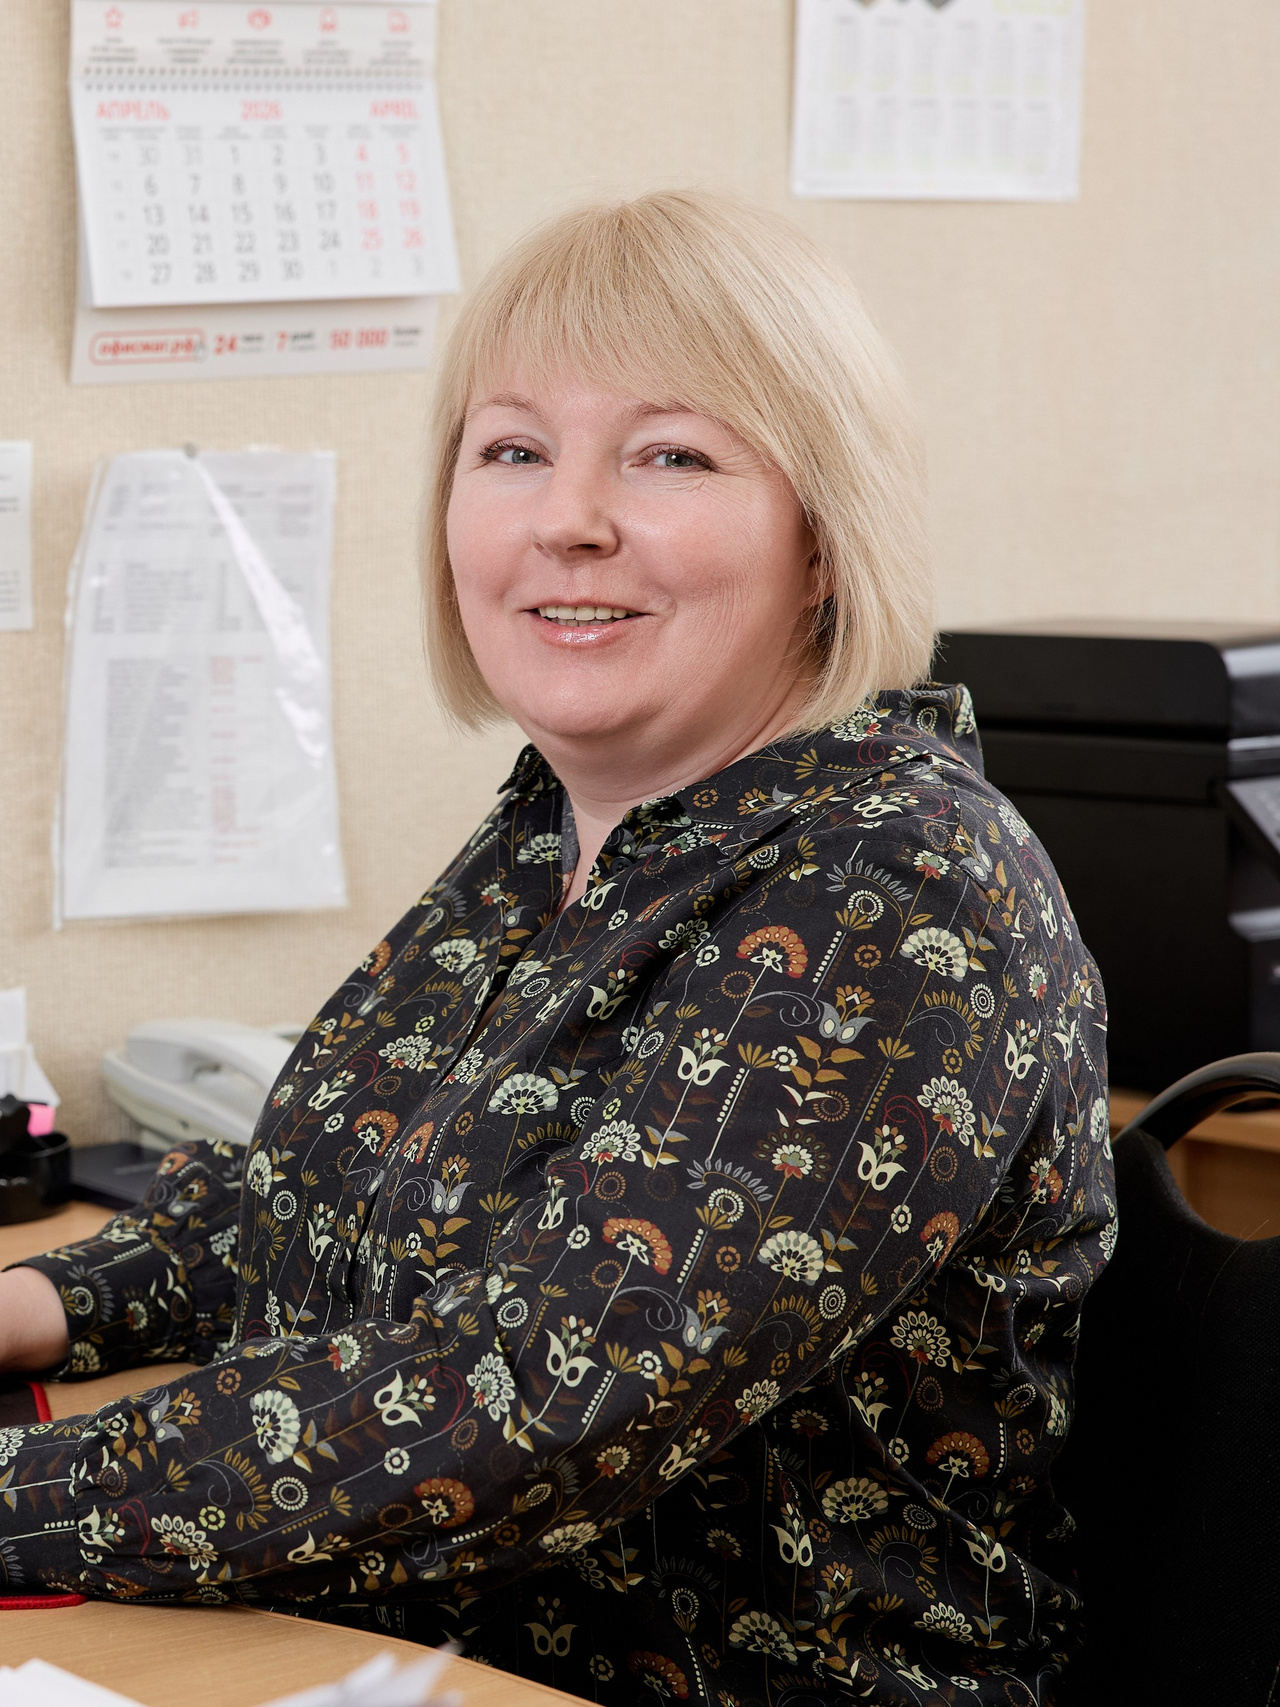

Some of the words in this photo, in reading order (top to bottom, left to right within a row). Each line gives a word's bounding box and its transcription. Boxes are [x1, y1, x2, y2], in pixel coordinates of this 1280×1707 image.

[95, 100, 170, 120] АПРЕЛЬ
[240, 100, 283, 121] 2026
[369, 100, 420, 120] APRIL
[231, 144, 240, 165] 1
[272, 144, 284, 165] 2
[356, 142, 368, 162] 4
[144, 174, 158, 196] 6
[190, 173, 201, 196] 7
[231, 173, 246, 196] 8
[274, 173, 288, 195] 9
[312, 172, 335, 194] 10
[355, 171, 375, 191] 11
[396, 170, 417, 192] 12
[143, 205, 165, 227] 13
[188, 204, 210, 226] 14
[231, 204, 253, 225] 15
[274, 203, 297, 224] 16
[316, 201, 337, 222] 17
[357, 200, 379, 221] 18
[399, 200, 421, 221] 19
[146, 234, 170, 256] 20
[191, 233, 213, 255] 21
[234, 232, 256, 254] 22
[277, 232, 300, 253] 23
[319, 230, 341, 252] 24
[361, 229, 383, 250] 25
[402, 229, 424, 250] 26
[150, 263, 172, 285] 27
[194, 262, 218, 284] 28
[238, 261, 261, 283] 29
[280, 260, 303, 282] 30
[213, 334, 237, 355] 24
[277, 330, 289, 352] 7
